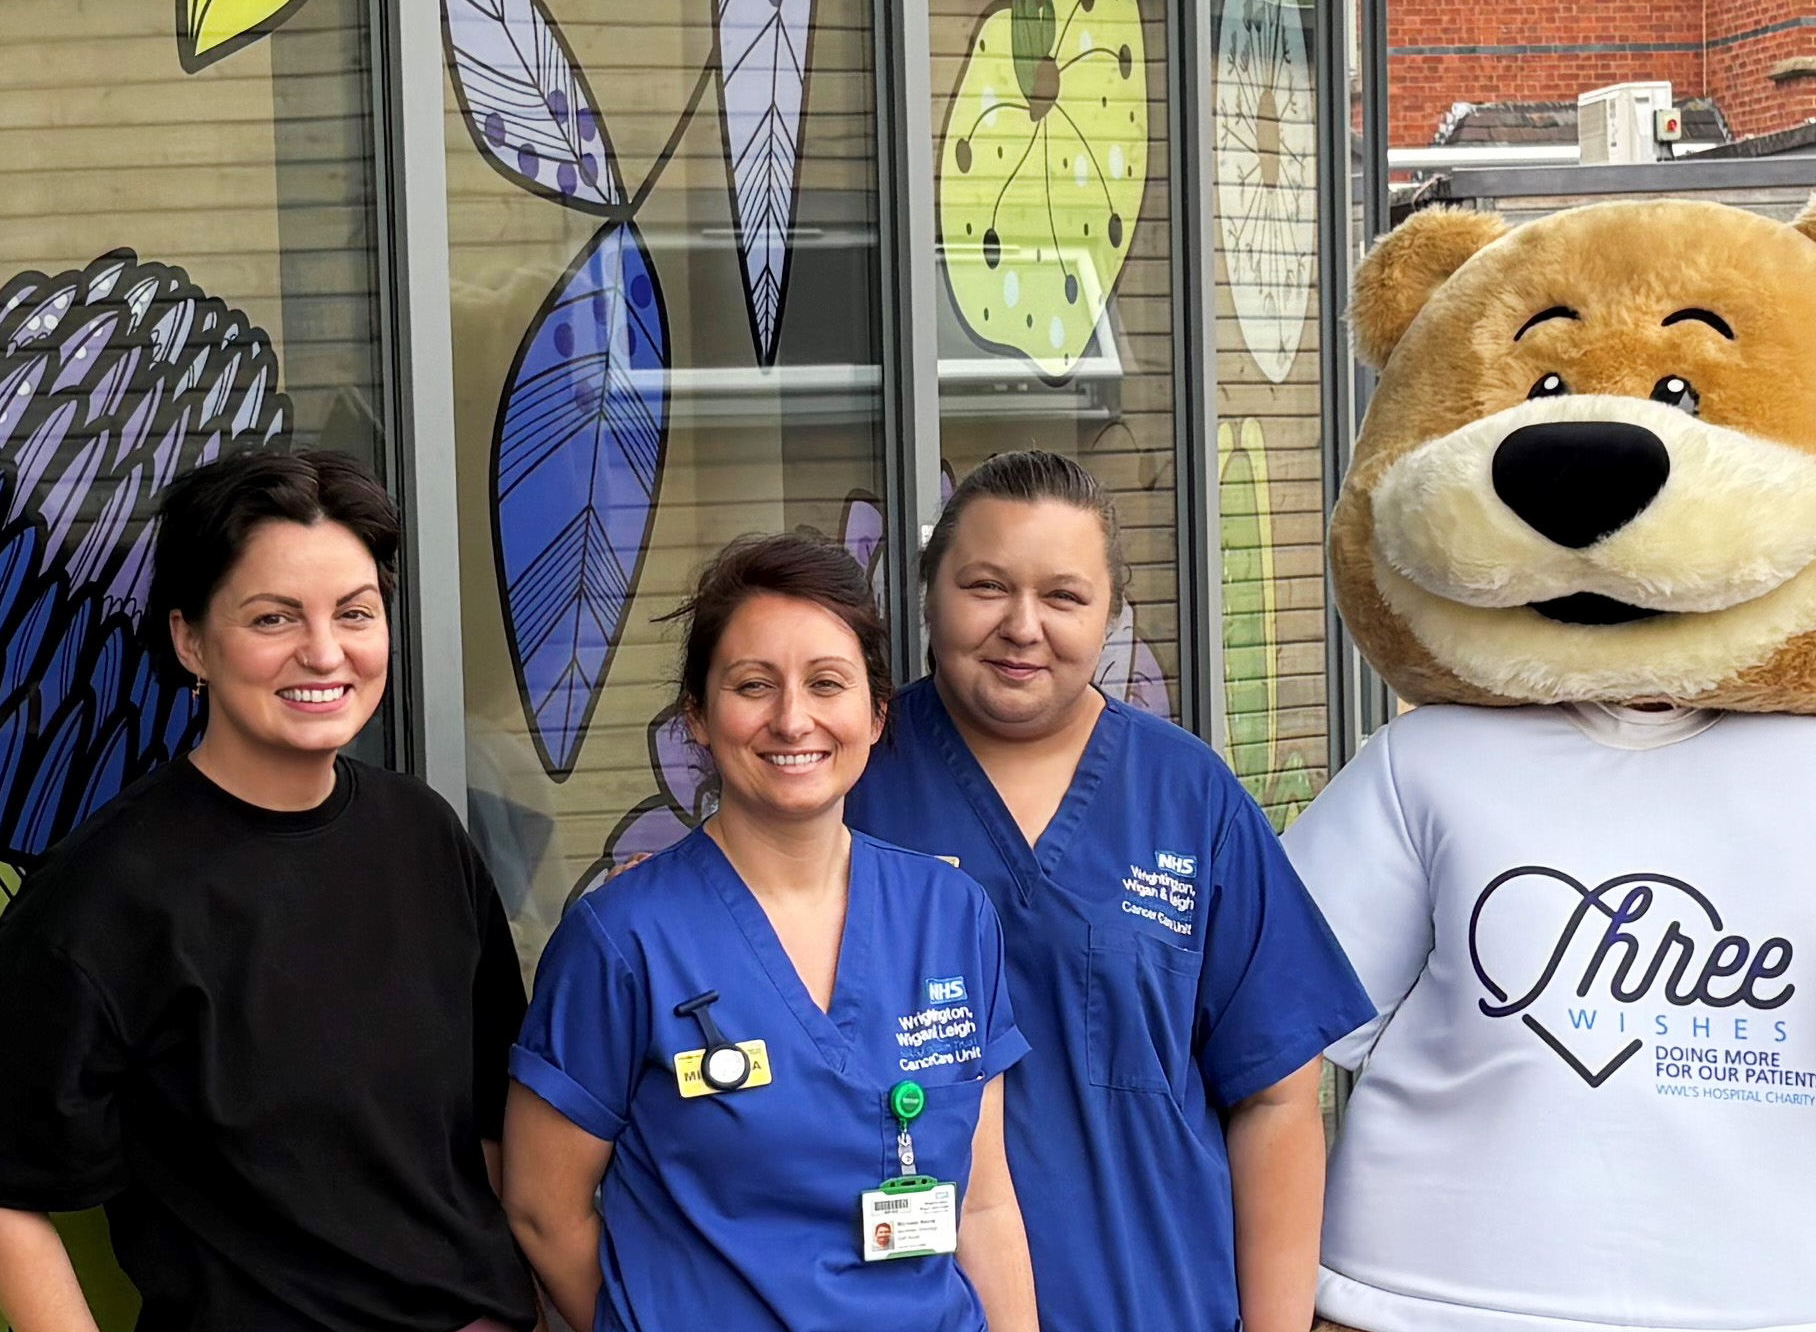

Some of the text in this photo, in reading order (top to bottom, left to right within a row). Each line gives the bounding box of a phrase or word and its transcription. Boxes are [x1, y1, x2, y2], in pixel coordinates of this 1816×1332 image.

[1158, 854, 1195, 875] NHS
[1469, 866, 1796, 1018] Three
[929, 980, 964, 1001] NHS
[1568, 1009, 1788, 1043] WISHES
[955, 1046, 981, 1063] Unit
[1655, 1045, 1781, 1067] DOING MORE
[1655, 1062, 1693, 1079] FOR
[1698, 1065, 1739, 1083] OUR
[1656, 1084, 1816, 1106] WWL'S HOSPITAL CHARITY
